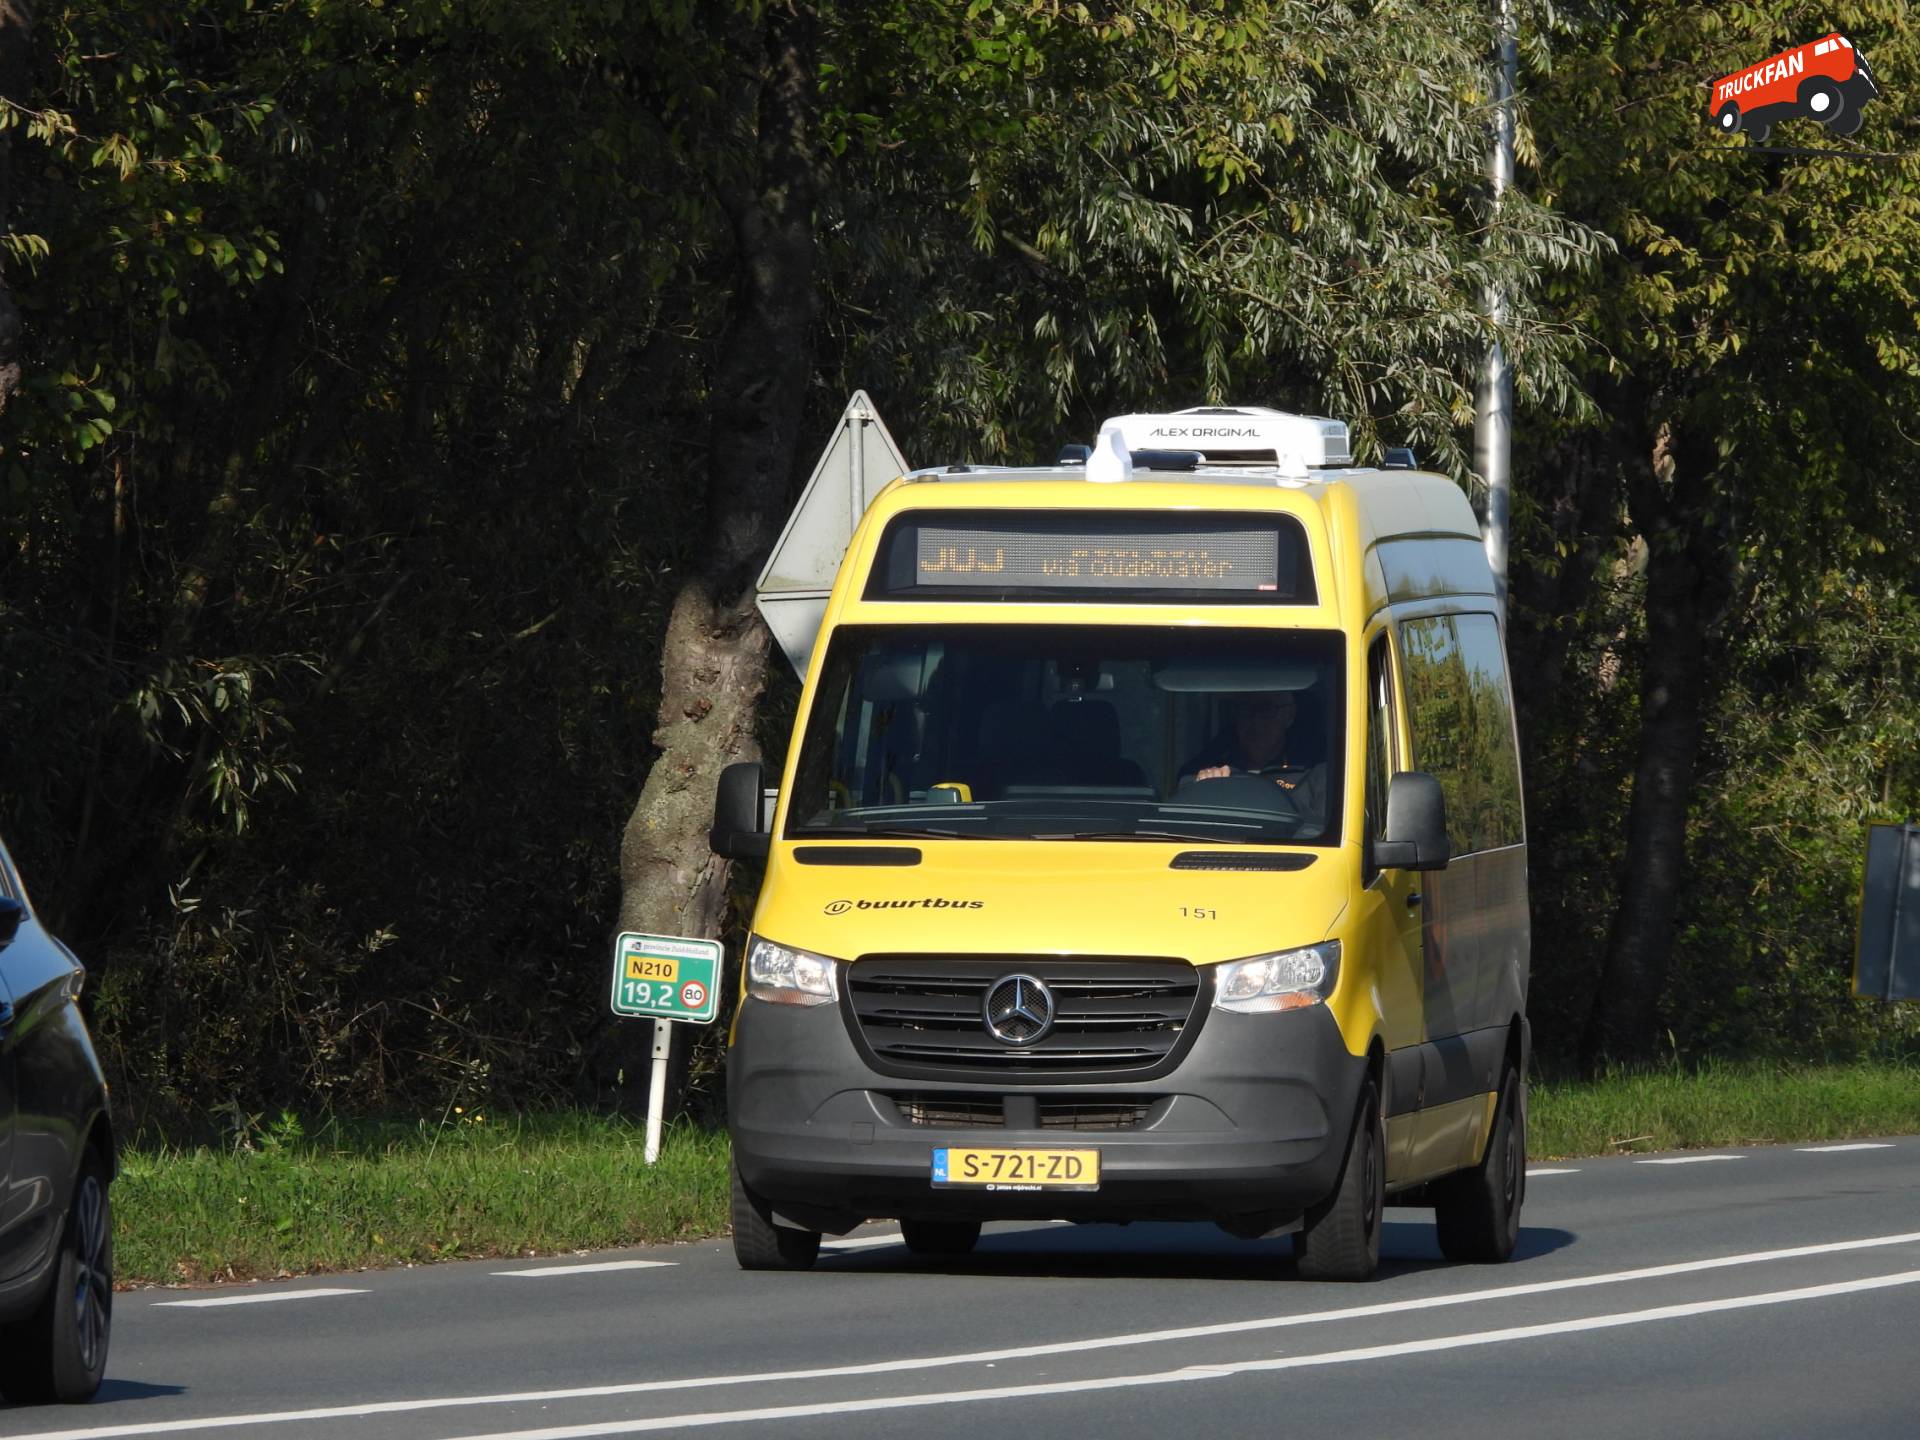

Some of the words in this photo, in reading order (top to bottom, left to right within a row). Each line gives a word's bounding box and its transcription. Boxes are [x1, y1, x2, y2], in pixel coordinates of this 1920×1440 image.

[1150, 427, 1189, 437] ALEX
[1192, 428, 1261, 438] ORIGINAL
[856, 898, 985, 910] buurtbus
[1179, 906, 1216, 920] 151
[632, 961, 672, 977] N210
[624, 981, 673, 1008] 19,2
[684, 988, 702, 1001] 80
[934, 1168, 947, 1177] NL
[963, 1154, 1082, 1179] S-721-ZD
